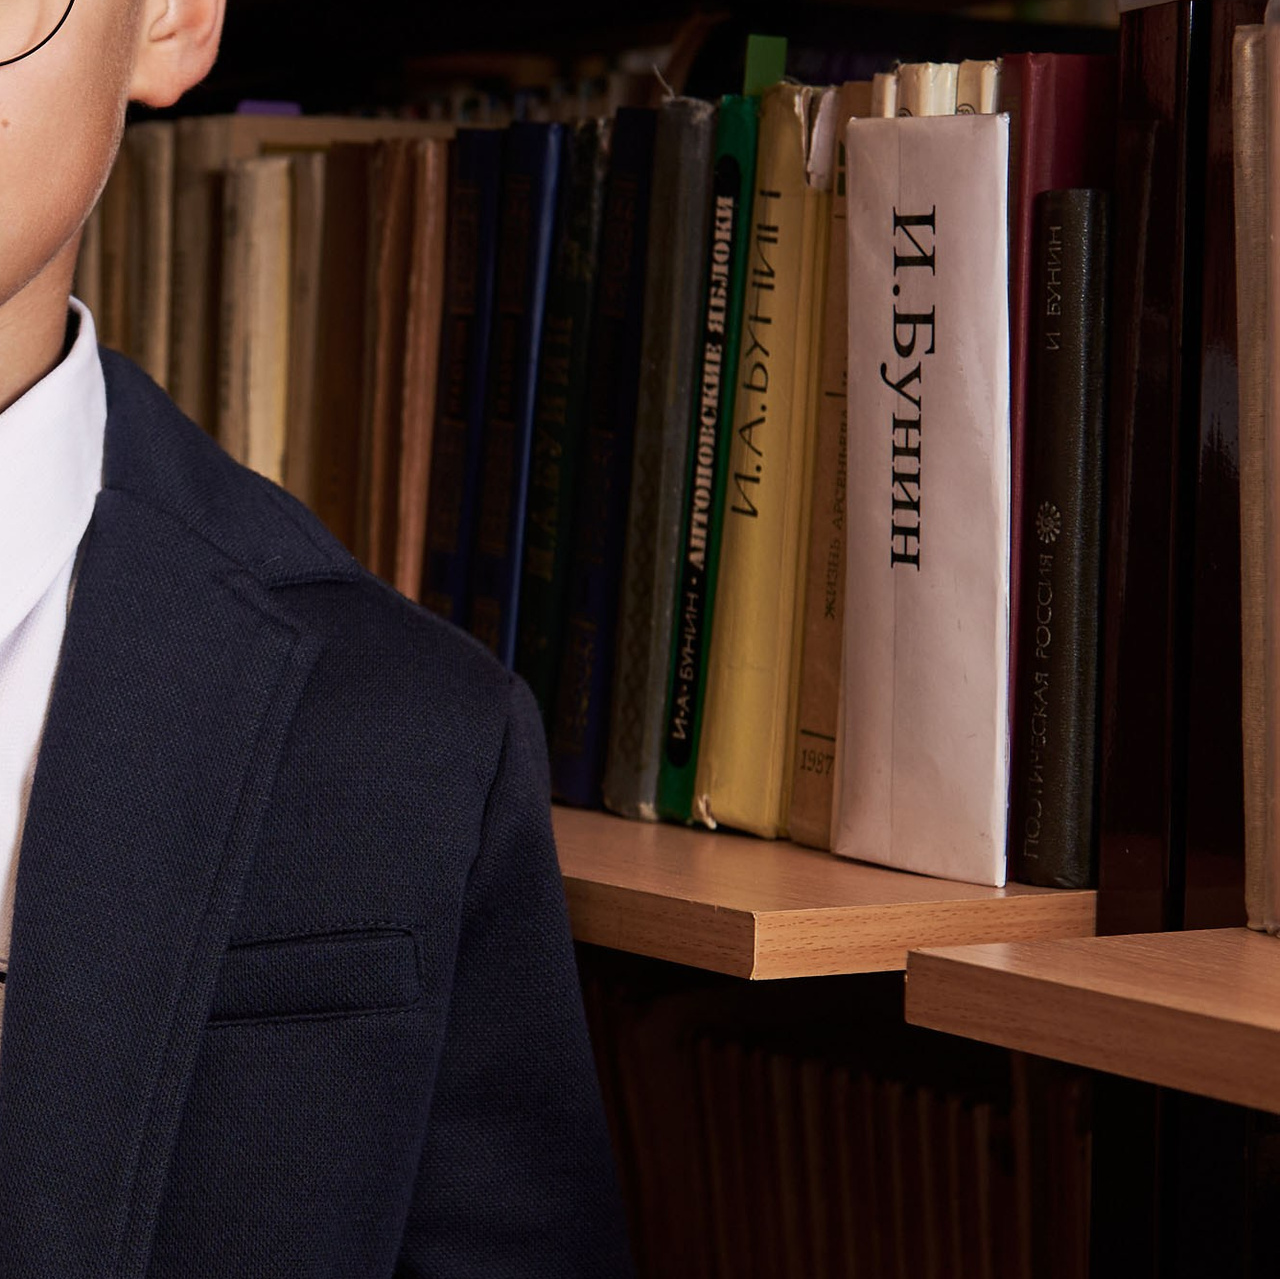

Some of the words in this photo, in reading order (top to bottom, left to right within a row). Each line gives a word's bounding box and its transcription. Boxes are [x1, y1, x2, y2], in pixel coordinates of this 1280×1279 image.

[1047, 225, 1062, 316] БУНИН
[688, 342, 724, 571] АНТОНОВСКИЕ
[708, 196, 734, 335] ЯБЛОКИ
[881, 204, 936, 572] И.Бунин
[825, 540, 841, 620] ЖИЗНЬ
[1036, 554, 1054, 658] РОССИЯ
[800, 748, 835, 775] 1987
